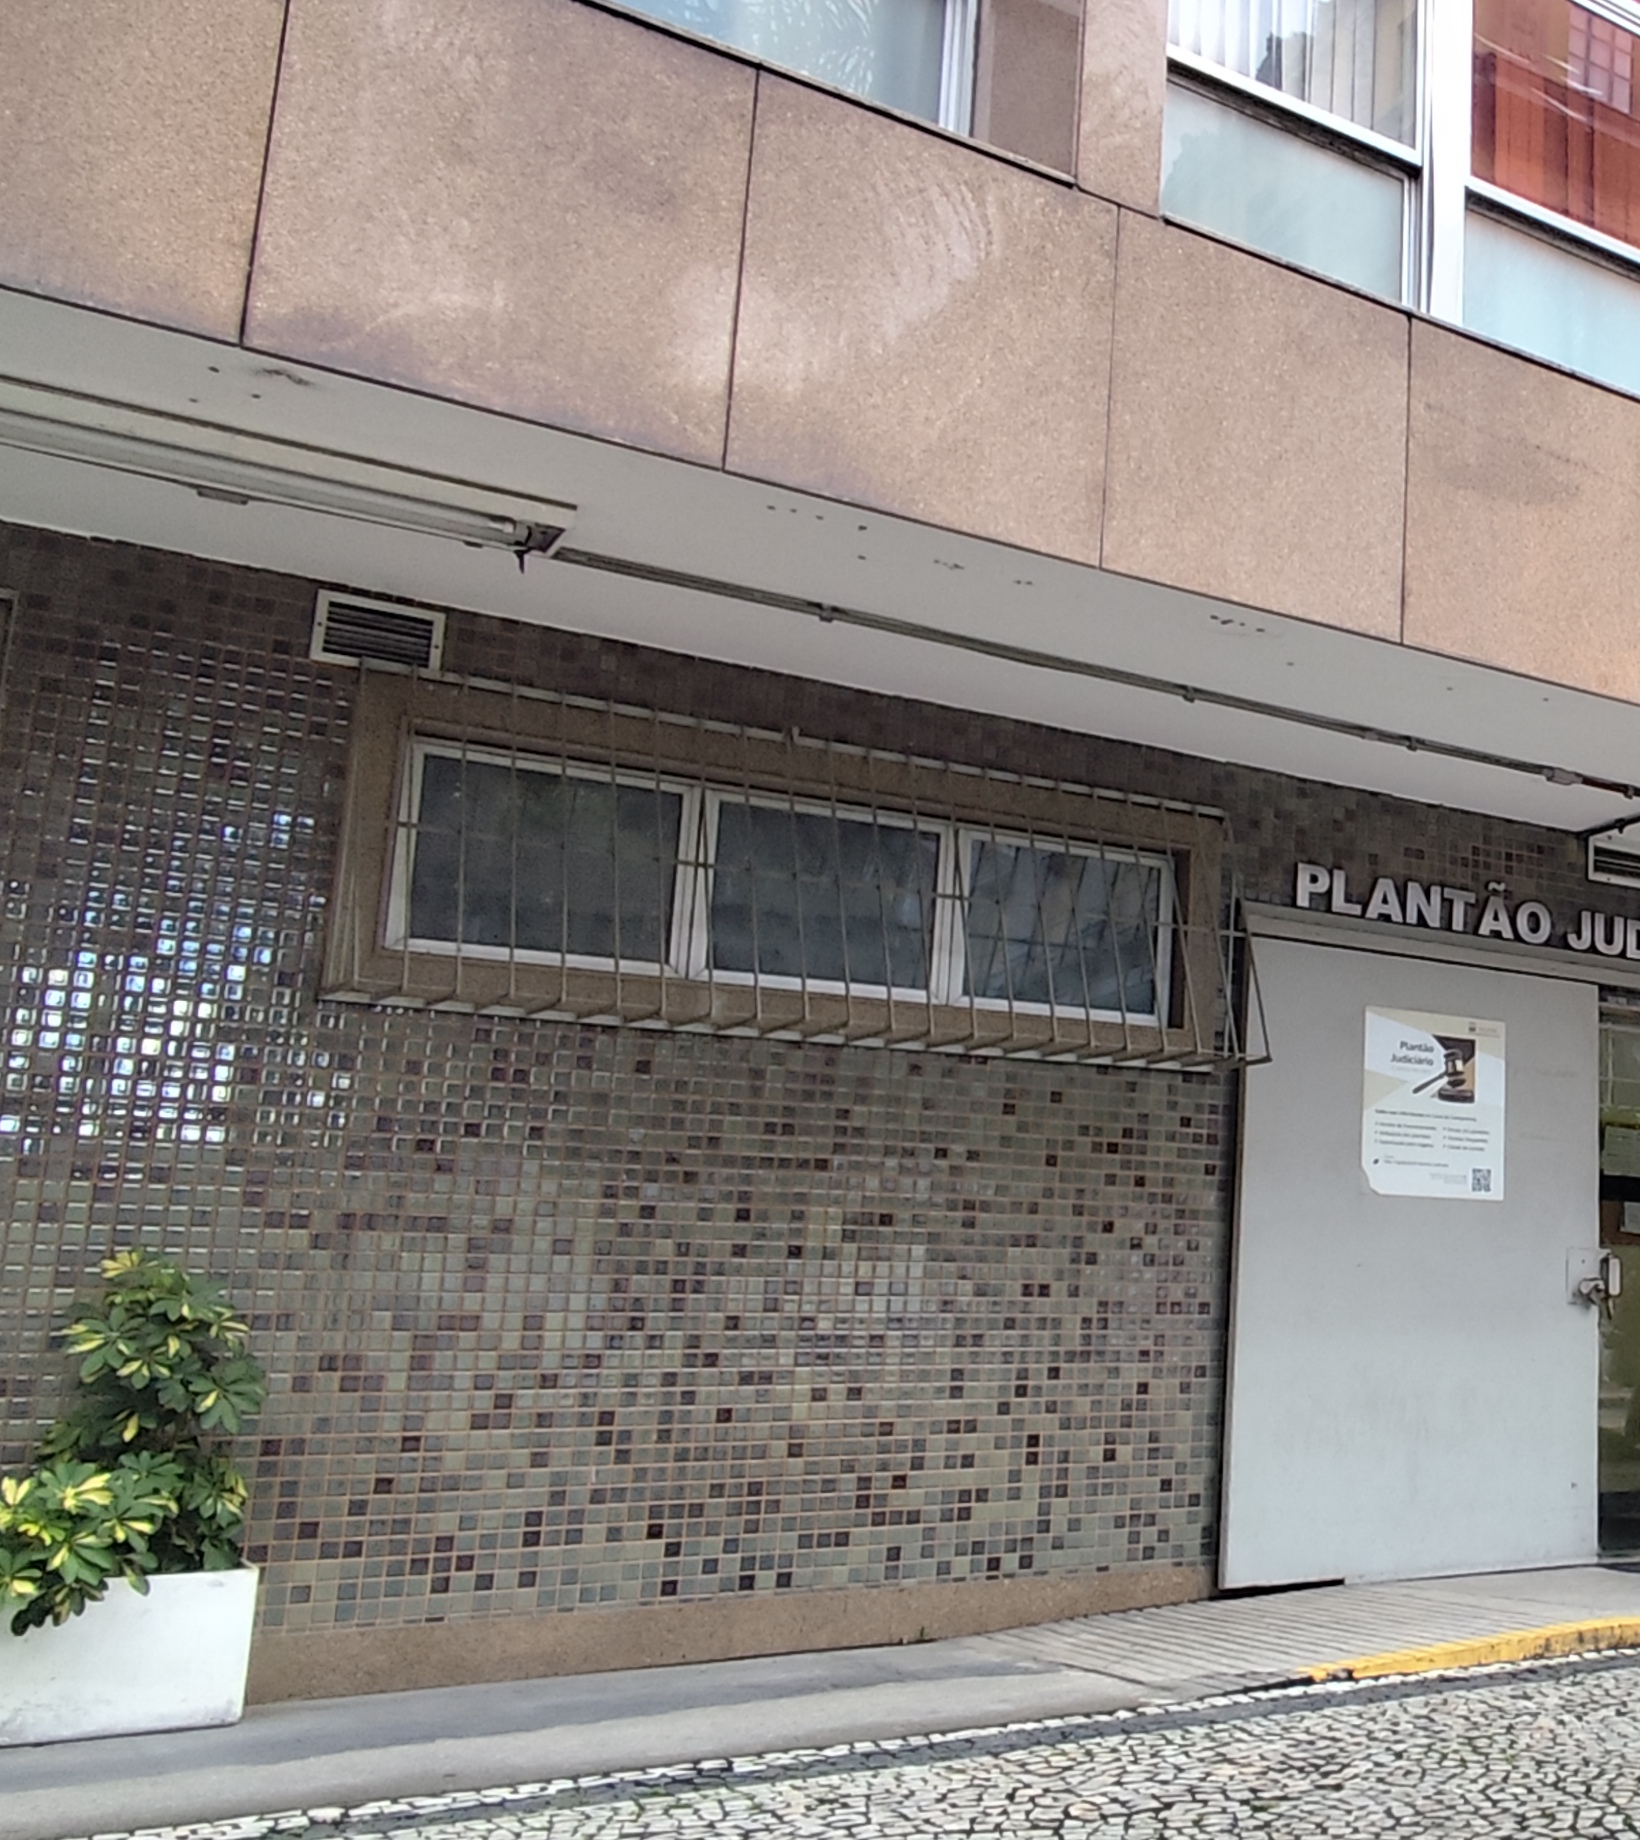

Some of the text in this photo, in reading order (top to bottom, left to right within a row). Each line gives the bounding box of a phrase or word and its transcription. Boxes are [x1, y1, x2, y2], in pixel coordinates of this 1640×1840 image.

[1296, 862, 1552, 945] PLANTÃO
[1400, 1040, 1435, 1053] Plantão
[1390, 1053, 1434, 1067] Judiciário
